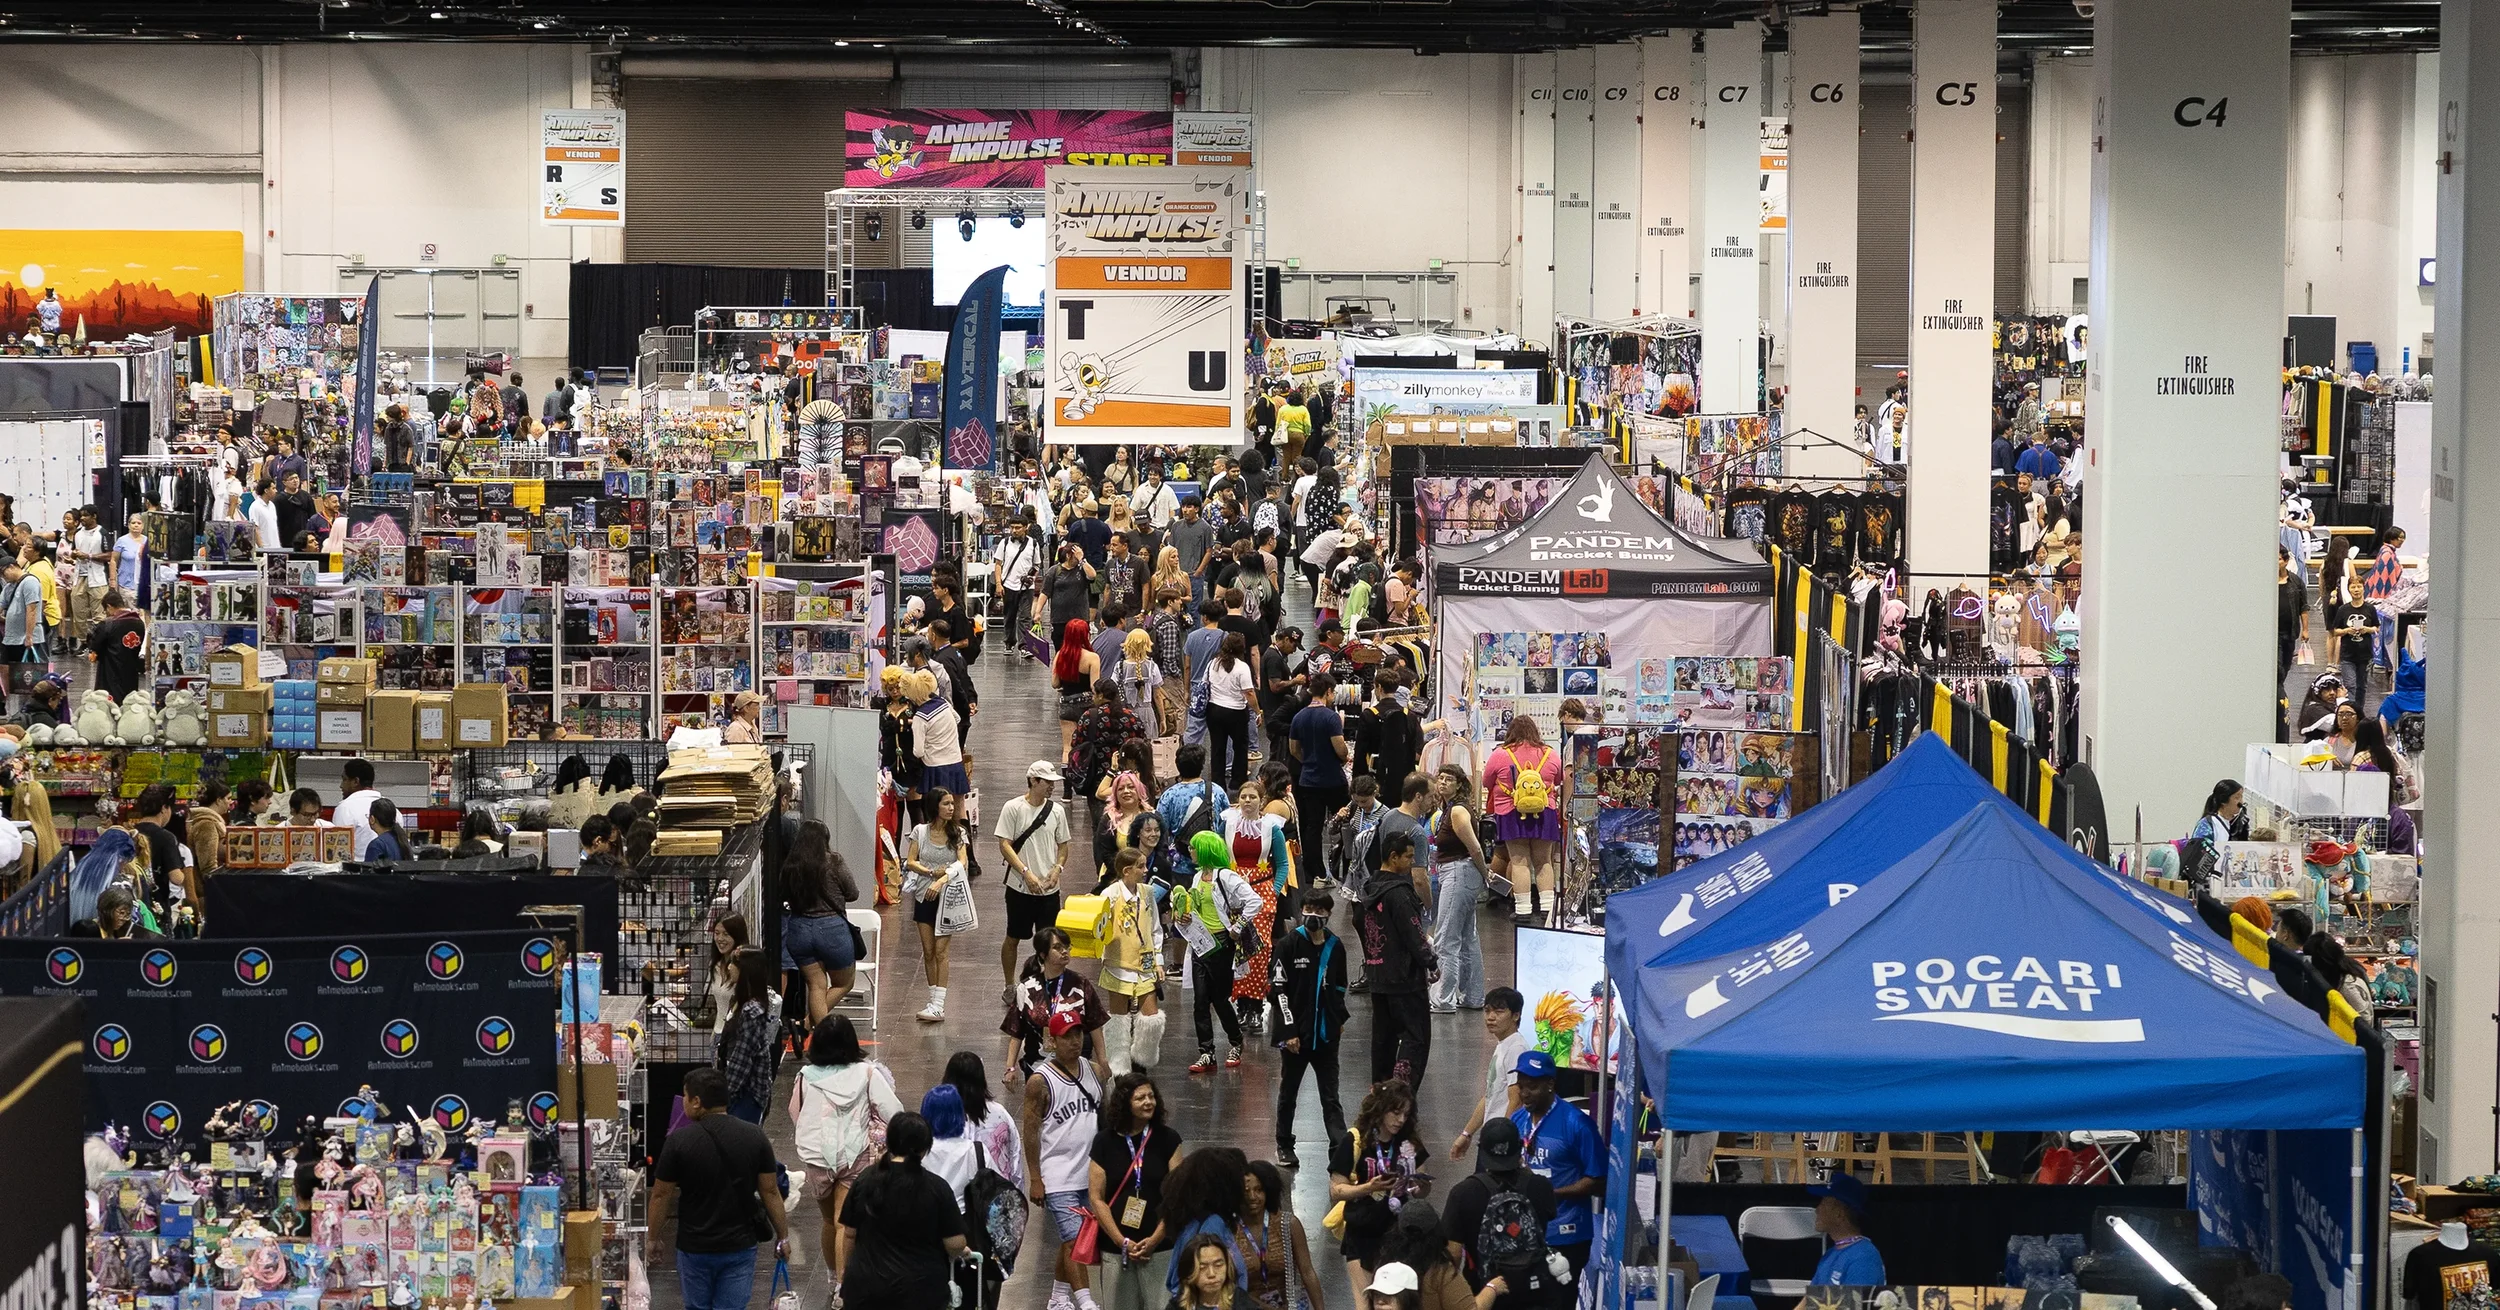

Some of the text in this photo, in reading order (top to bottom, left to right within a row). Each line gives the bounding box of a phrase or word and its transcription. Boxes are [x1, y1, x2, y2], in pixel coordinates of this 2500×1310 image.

[1530, 89, 1553, 100] C11
[1562, 88, 1589, 101] C10
[1604, 87, 1628, 101] C9
[1654, 86, 1680, 101] C8
[1718, 85, 1750, 103] C7
[1810, 83, 1844, 104] C6
[1935, 82, 1978, 106] C5
[2173, 96, 2229, 128] C4
[924, 120, 1012, 145] ANIME
[565, 150, 601, 159] VENDOR
[948, 136, 1065, 163] IMPULSE
[1198, 154, 1234, 162] VENDOR
[546, 165, 563, 183] R
[601, 187, 618, 205] S
[1569, 192, 1579, 200] FIRE
[1059, 190, 1167, 217] ANIME
[1165, 203, 1190, 211] ORANGE
[1559, 200, 1589, 208] EXTINGUISHER
[1609, 203, 1620, 211] FIRE
[1598, 211, 1631, 220] EXTINGUISHER
[1660, 217, 1672, 226] FIRE
[1085, 215, 1226, 242] IMPULSE
[1647, 227, 1685, 236] EXTINGUISHER
[1726, 236, 1739, 247] FIRE
[1711, 247, 1754, 258] EXTINGUISHER
[1103, 265, 1187, 282] VENDOR
[1816, 262, 1832, 274] FIRE
[1799, 276, 1849, 287] EXTINGUISHER
[1945, 299, 1962, 313] FIRE
[1059, 300, 1094, 341] T
[1923, 316, 1984, 330] EXTINGUISHER
[959, 299, 979, 411] XAVIERCAL
[1294, 351, 1322, 365] CRAZY
[1188, 350, 1227, 391] U
[1291, 360, 1326, 375] MONSTER
[2184, 356, 2208, 374] FIRE
[1403, 383, 1484, 399] zillymonkey
[2157, 377, 2235, 395] EXTINGUISHER
[1530, 536, 1675, 551] PANDEM
[1550, 550, 1675, 561] Rocket Bunny
[1458, 568, 1606, 590] PANDEM Lab
[1458, 583, 1560, 594] Rocket Bunny
[1652, 581, 1761, 595] PANDEMLab.COM
[629, 591, 651, 600] FRO
[1766, 932, 1815, 972] ARI
[1871, 954, 2123, 990] POCARI
[508, 978, 555, 990] Animebooks
[1875, 981, 2102, 1014] SWEAT
[1062, 1012, 1074, 1024] LA
[83, 1063, 146, 1075] nimebooks.com
